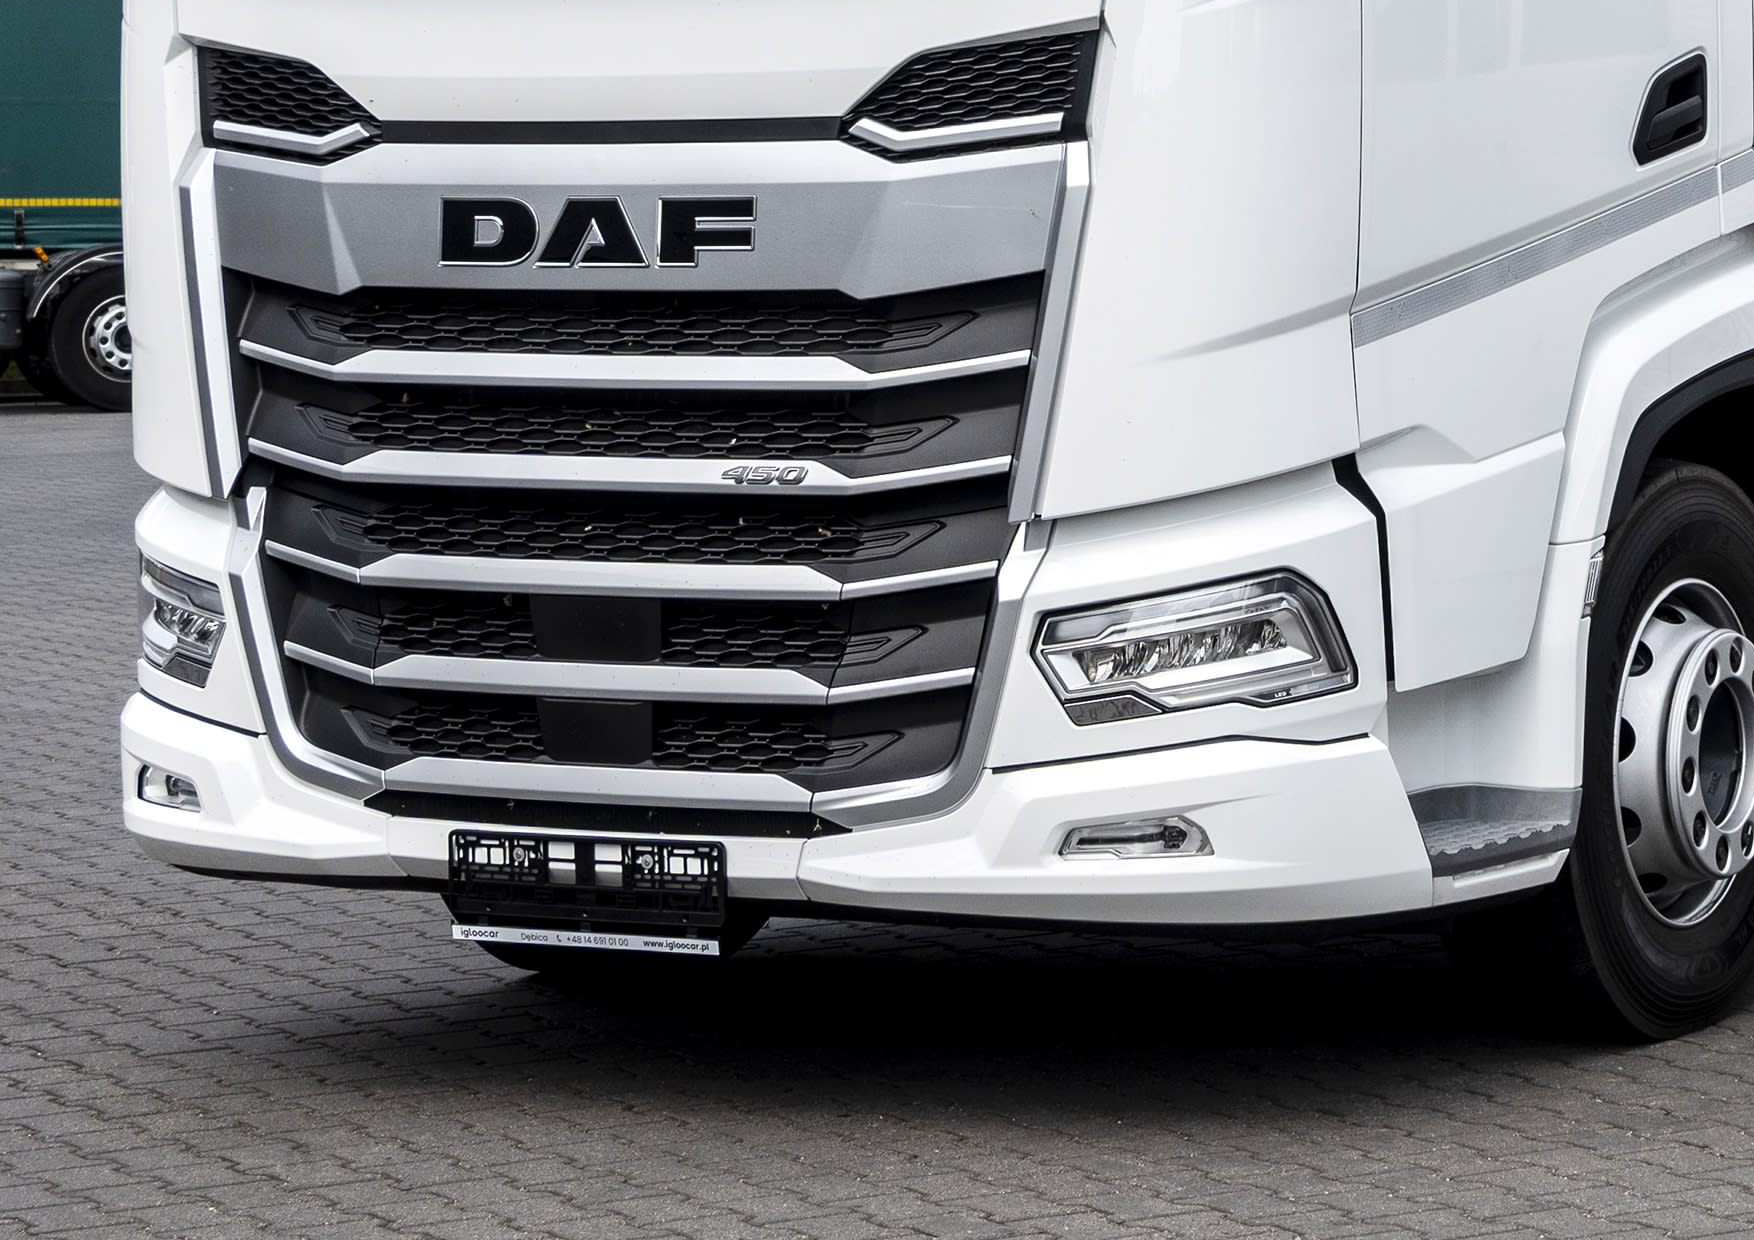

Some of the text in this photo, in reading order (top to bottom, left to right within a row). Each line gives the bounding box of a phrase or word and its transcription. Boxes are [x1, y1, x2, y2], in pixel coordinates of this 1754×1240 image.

[438, 194, 758, 269] DAF
[721, 465, 809, 485] 450
[460, 927, 710, 952] igloocar Dębica +48 14 691 01 00 www.igloocar.pl
